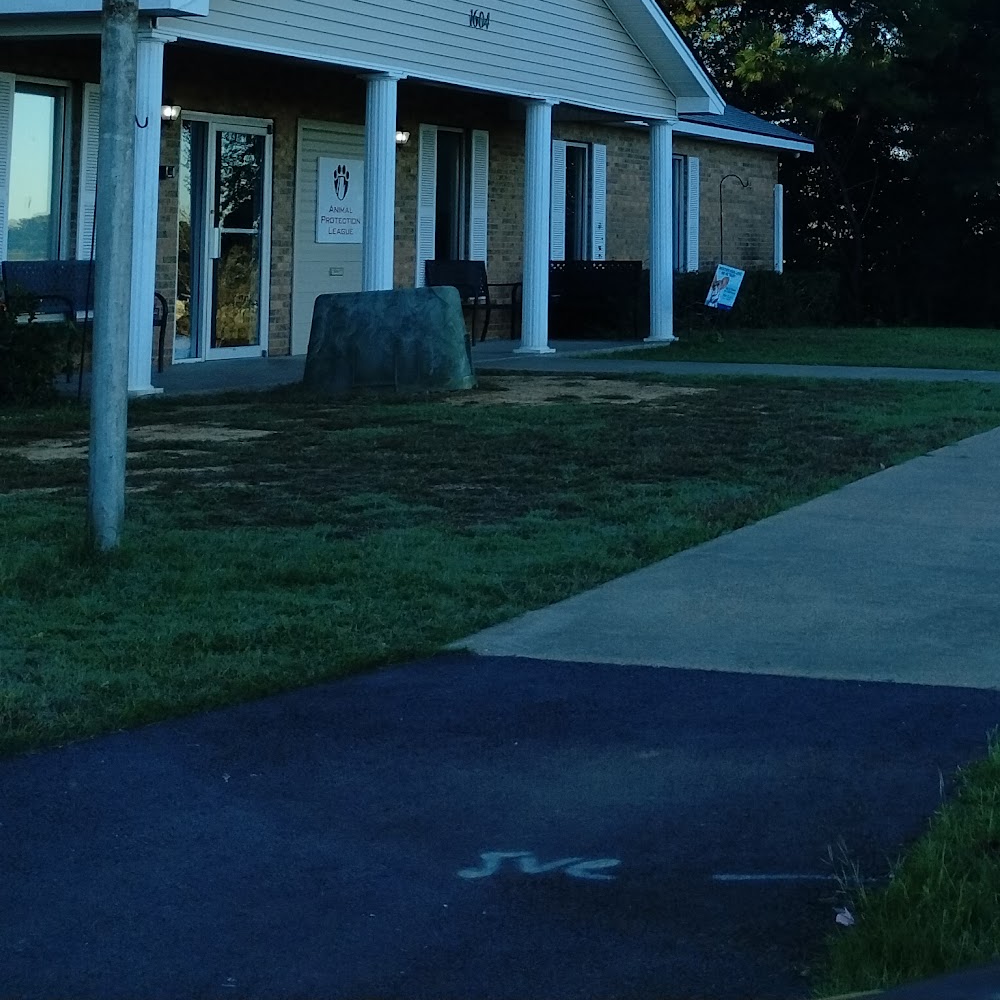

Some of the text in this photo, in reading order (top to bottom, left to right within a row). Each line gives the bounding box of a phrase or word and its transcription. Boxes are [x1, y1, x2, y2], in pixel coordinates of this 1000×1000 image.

[469, 9, 490, 30] 1604
[328, 205, 353, 214] ANIMAL
[320, 215, 361, 225] PROTECTION
[328, 227, 354, 235] LEAGUE
